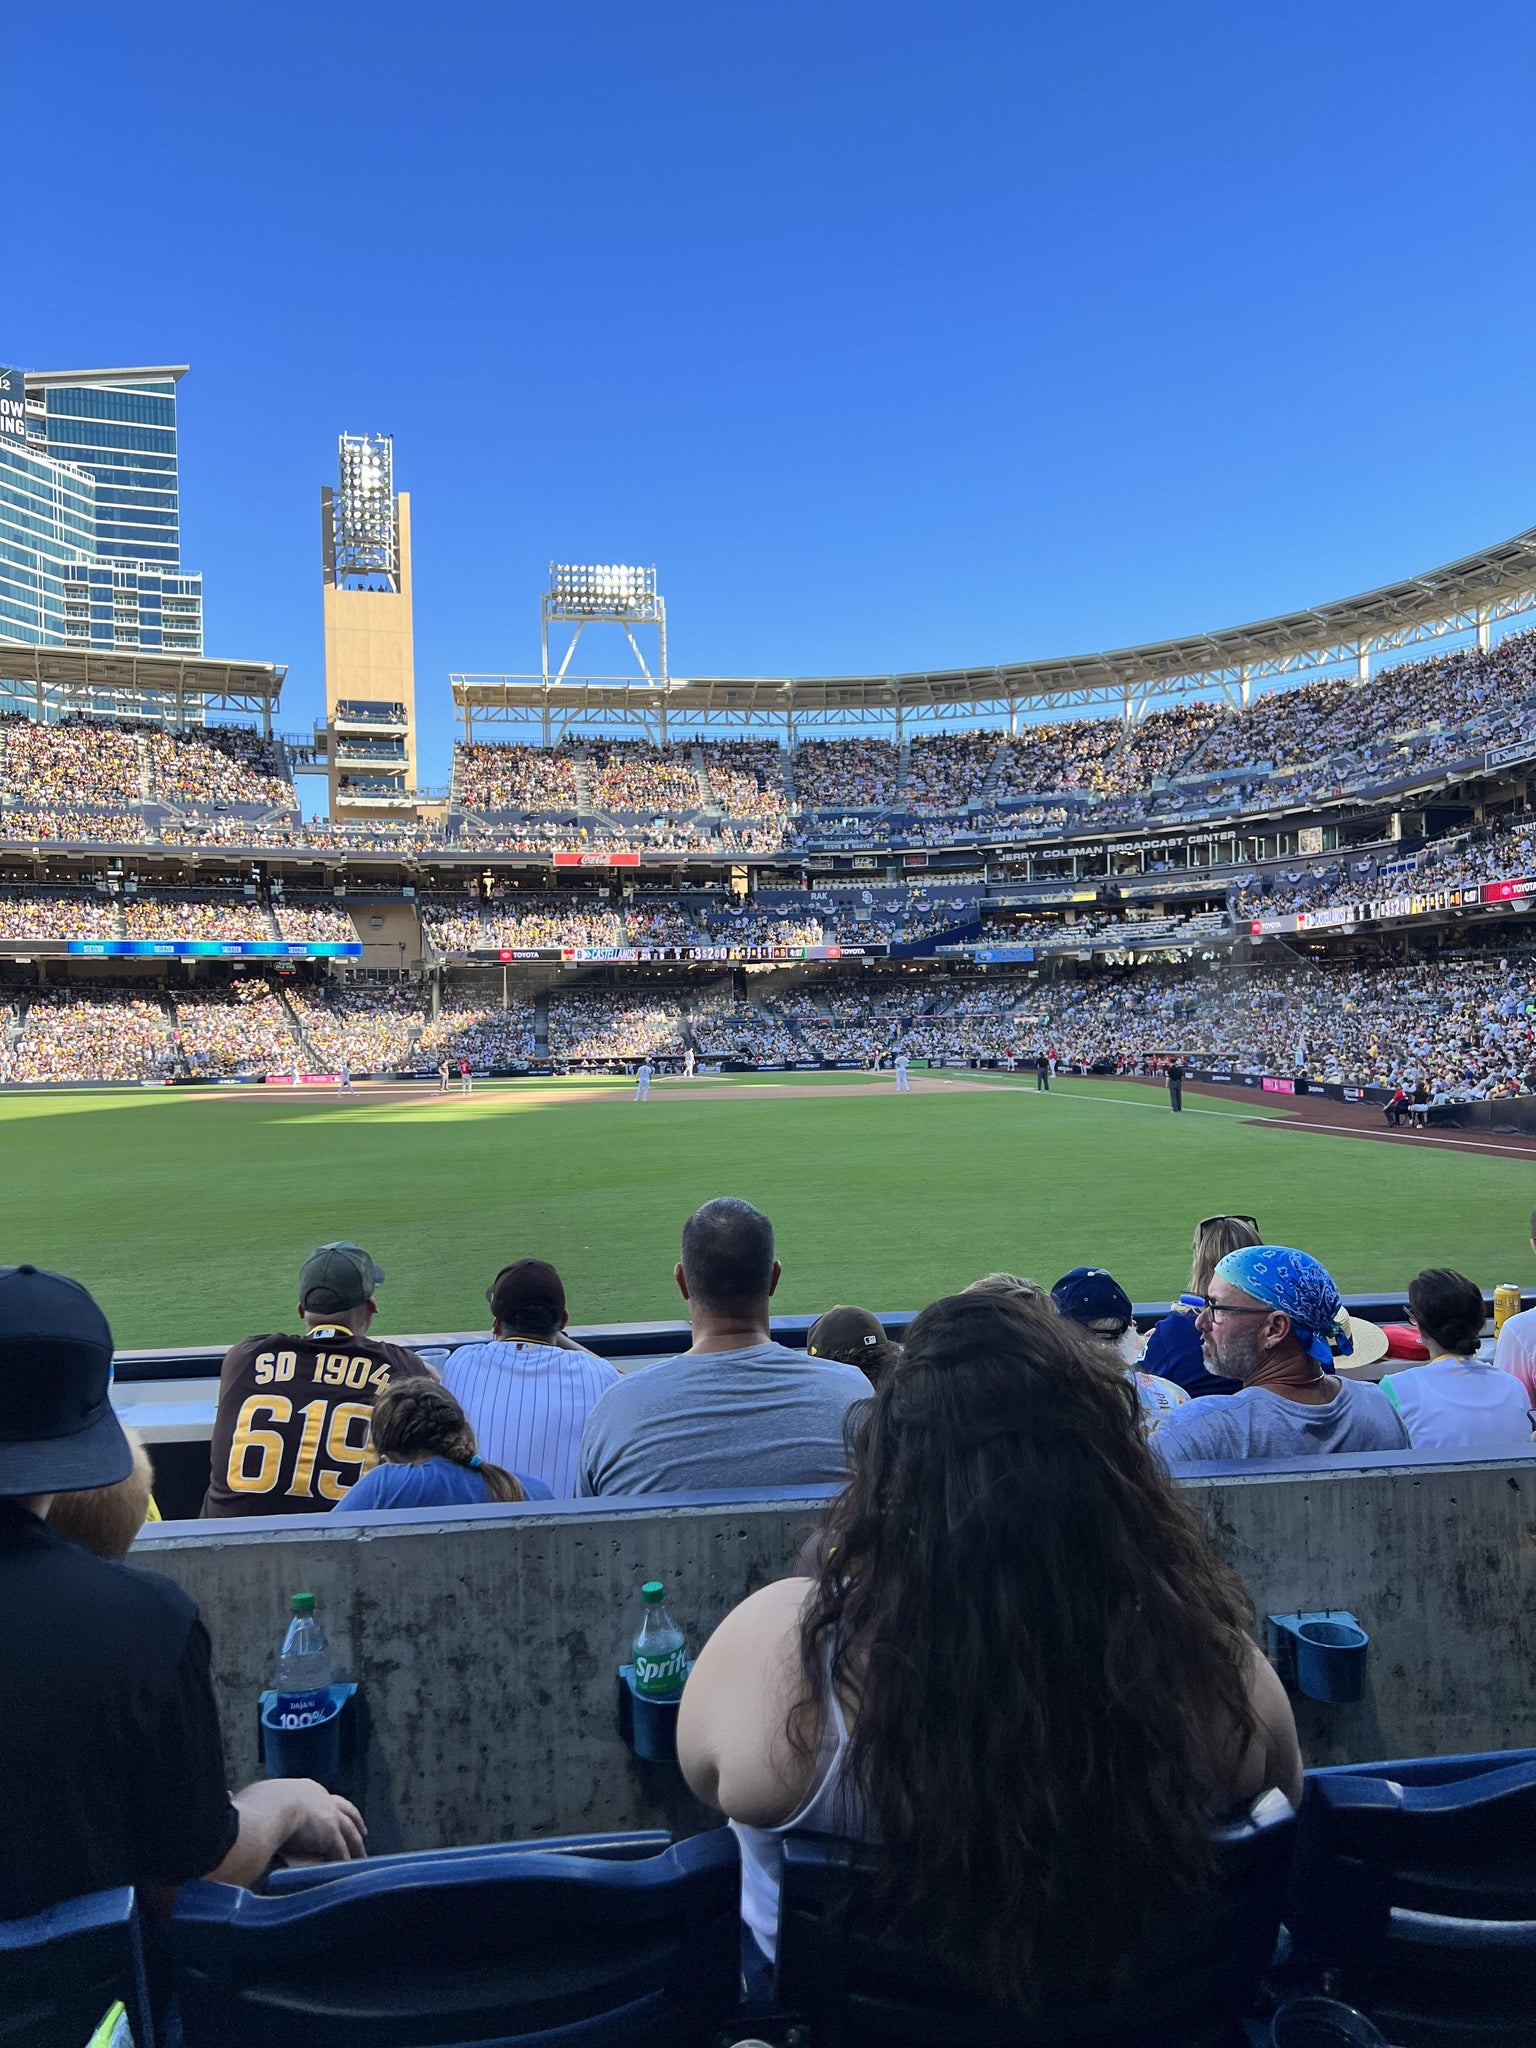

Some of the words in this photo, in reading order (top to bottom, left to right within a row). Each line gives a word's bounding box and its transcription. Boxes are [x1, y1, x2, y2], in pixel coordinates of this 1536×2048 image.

[998, 851, 1037, 862] JERRY
[1042, 845, 1104, 858] COLEMAN
[1107, 837, 1184, 853] BROADCAST
[1188, 831, 1237, 844] CENTER
[810, 892, 828, 900] RAK
[513, 951, 540, 959] TOYOTA
[591, 948, 636, 960] CASTELLANOS
[255, 1351, 297, 1385] SD
[311, 1352, 392, 1395] 1904
[226, 1394, 379, 1501] 619
